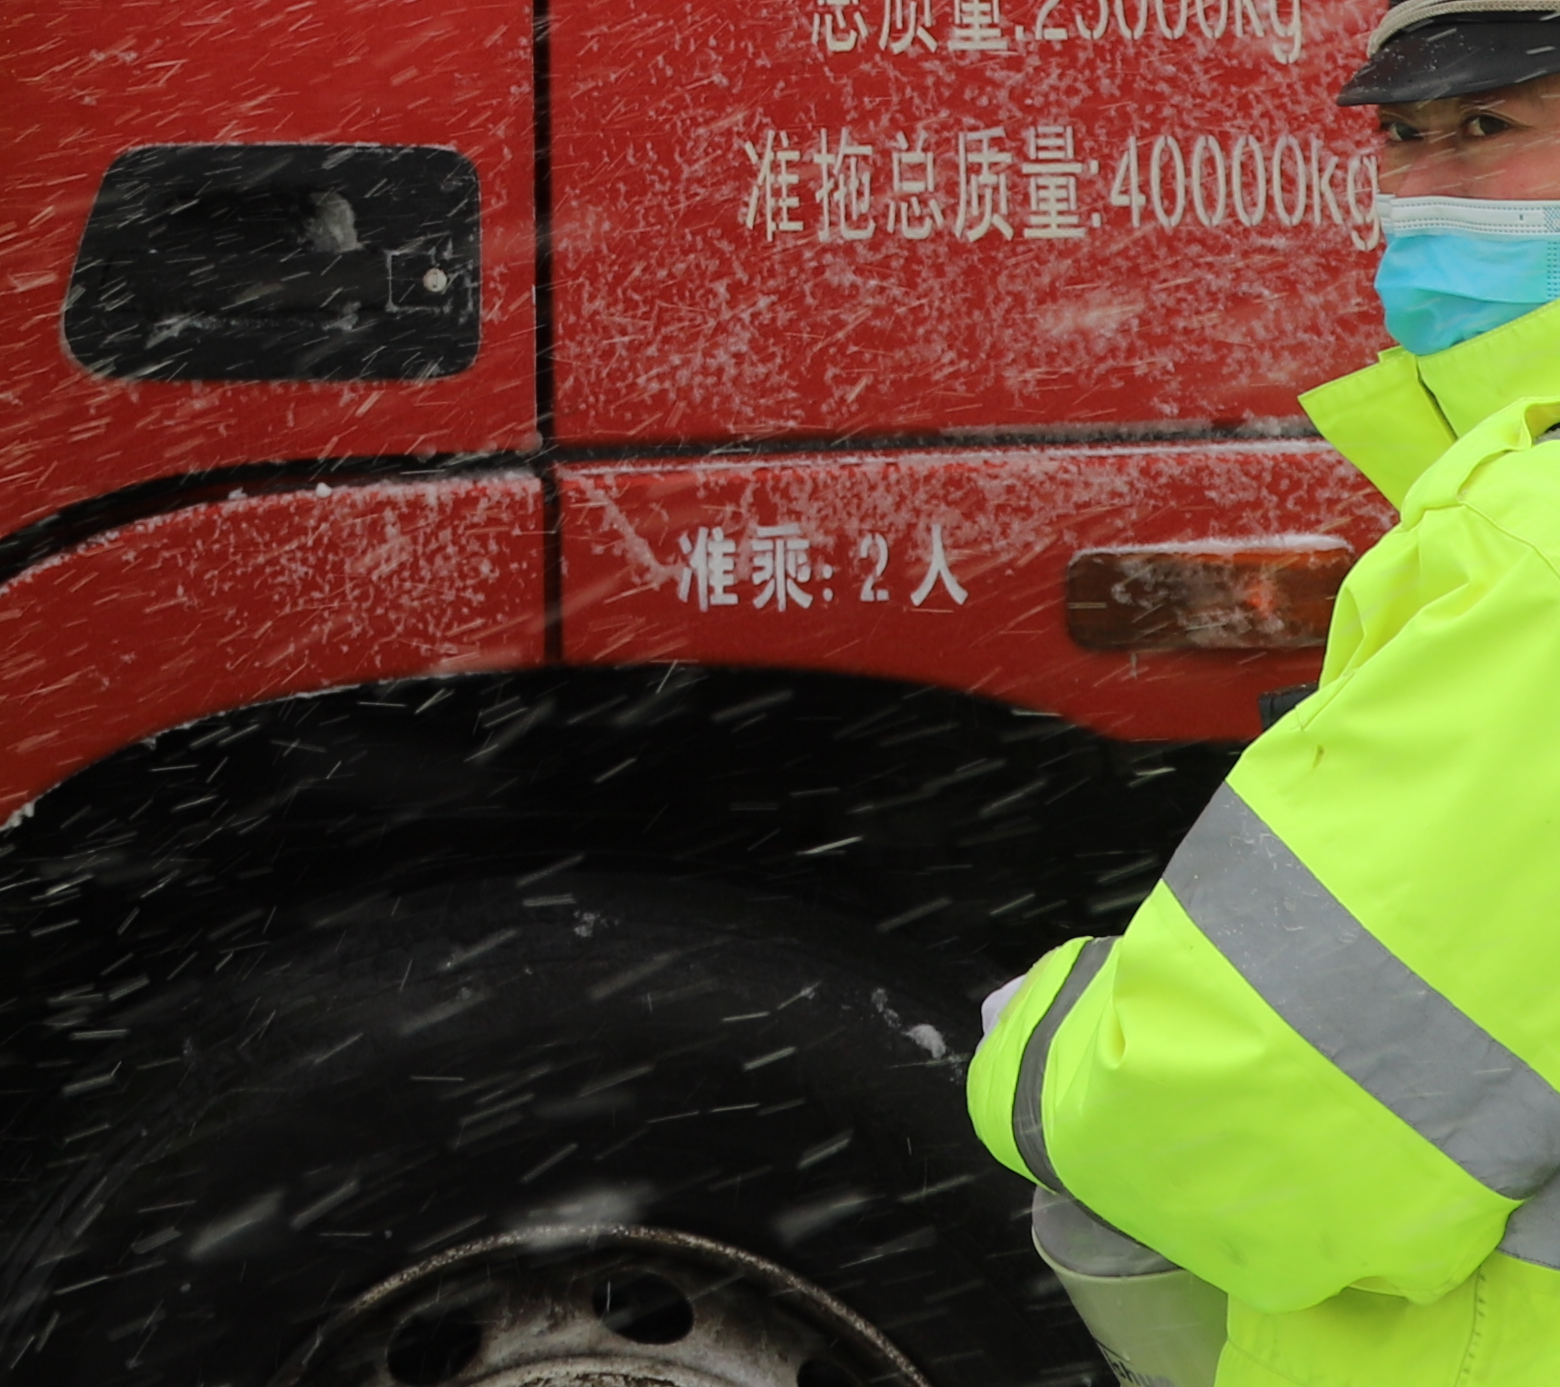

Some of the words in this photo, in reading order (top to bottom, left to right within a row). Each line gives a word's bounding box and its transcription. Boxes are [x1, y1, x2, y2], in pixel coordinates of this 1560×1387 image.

[744, 126, 1380, 252] 准拖总质量:40000kg
